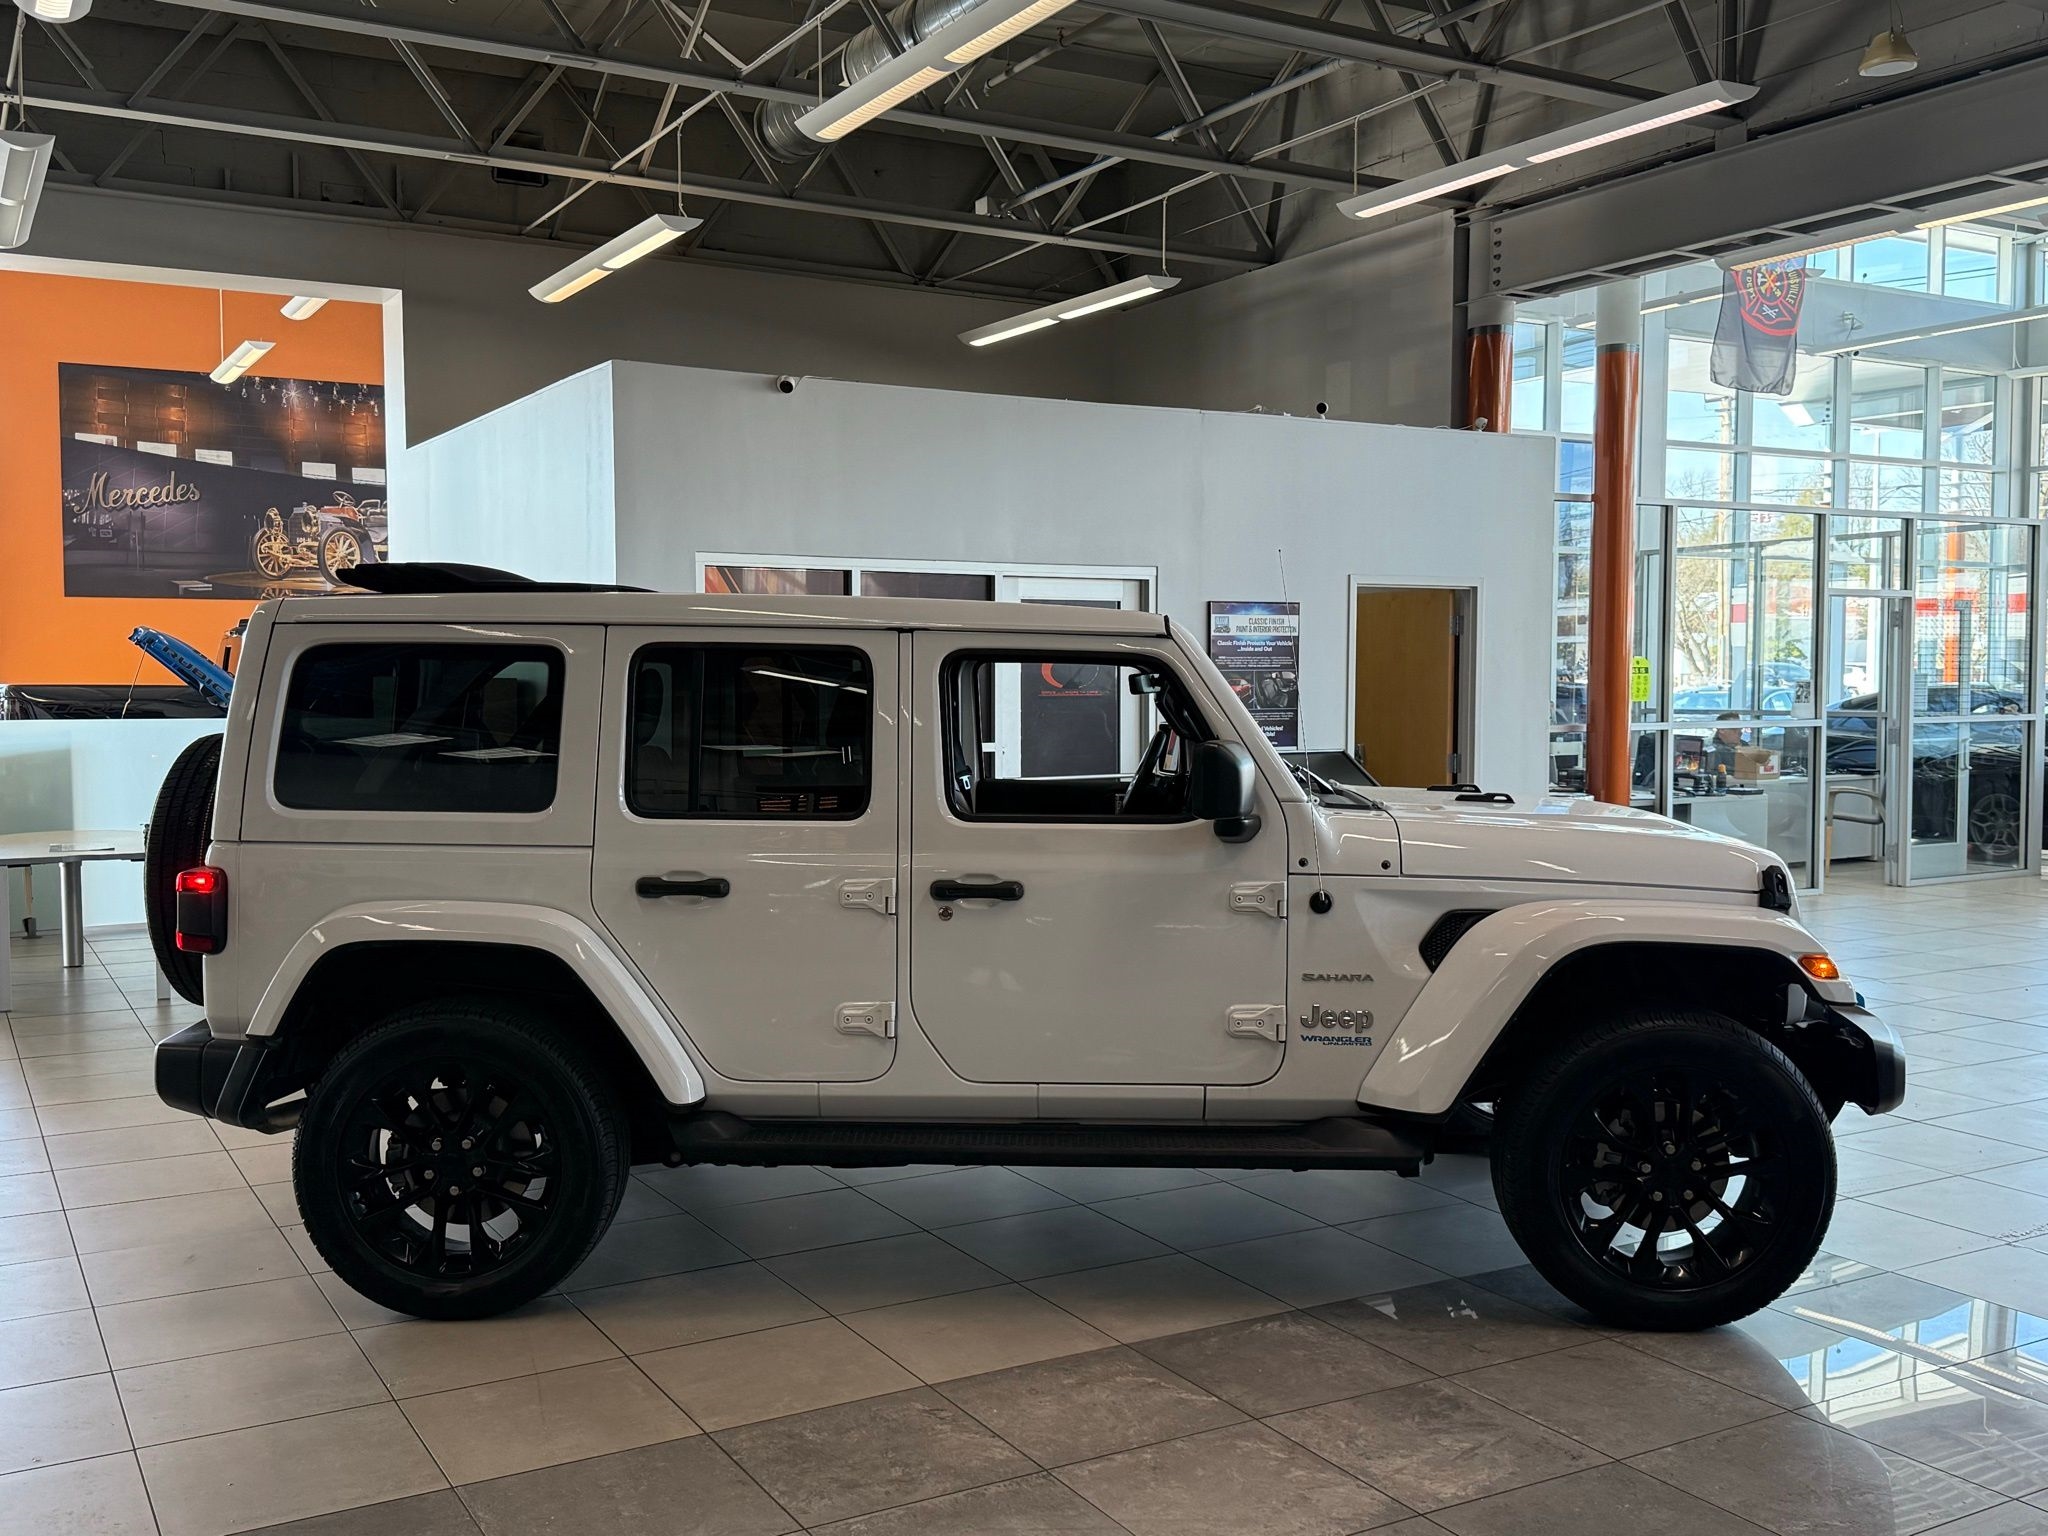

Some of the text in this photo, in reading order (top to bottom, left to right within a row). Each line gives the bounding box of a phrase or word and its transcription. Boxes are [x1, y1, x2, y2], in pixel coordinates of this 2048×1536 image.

[73, 470, 201, 514] Mercedes
[1248, 617, 1285, 625] CLASSIC FINISH
[1235, 625, 1249, 633] PAINT
[1253, 625, 1271, 633] INTERIOR
[1273, 625, 1297, 633] PROTECTION
[1301, 973, 1374, 982] SAHARA
[1300, 1003, 1374, 1034] Jeep
[1301, 1034, 1372, 1042] WRANGLER
